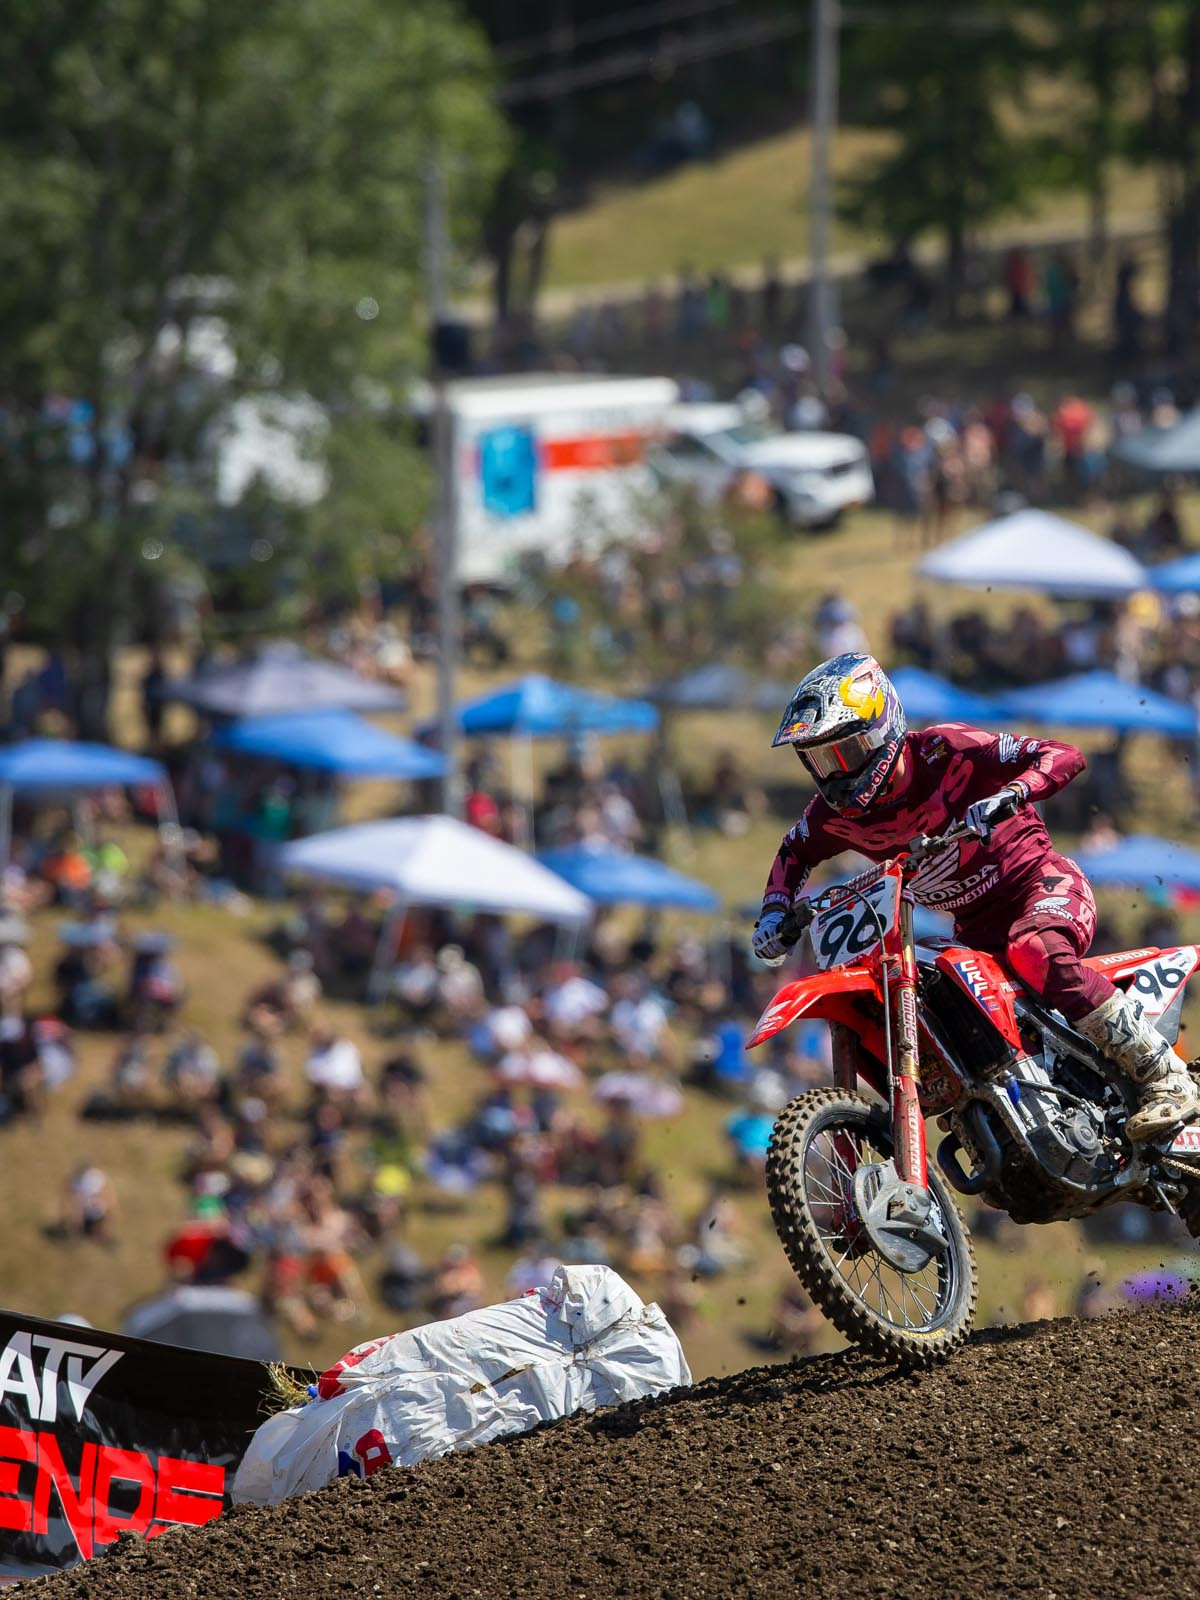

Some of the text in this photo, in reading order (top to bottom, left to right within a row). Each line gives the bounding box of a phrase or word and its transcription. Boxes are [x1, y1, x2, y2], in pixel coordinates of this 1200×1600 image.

[914, 864, 998, 904] HONDA
[927, 871, 1000, 911] PROGRESSIVE
[820, 897, 888, 971] 96
[1098, 948, 1155, 966] HONDA
[960, 960, 989, 998] CRF
[1133, 960, 1187, 1002] 96
